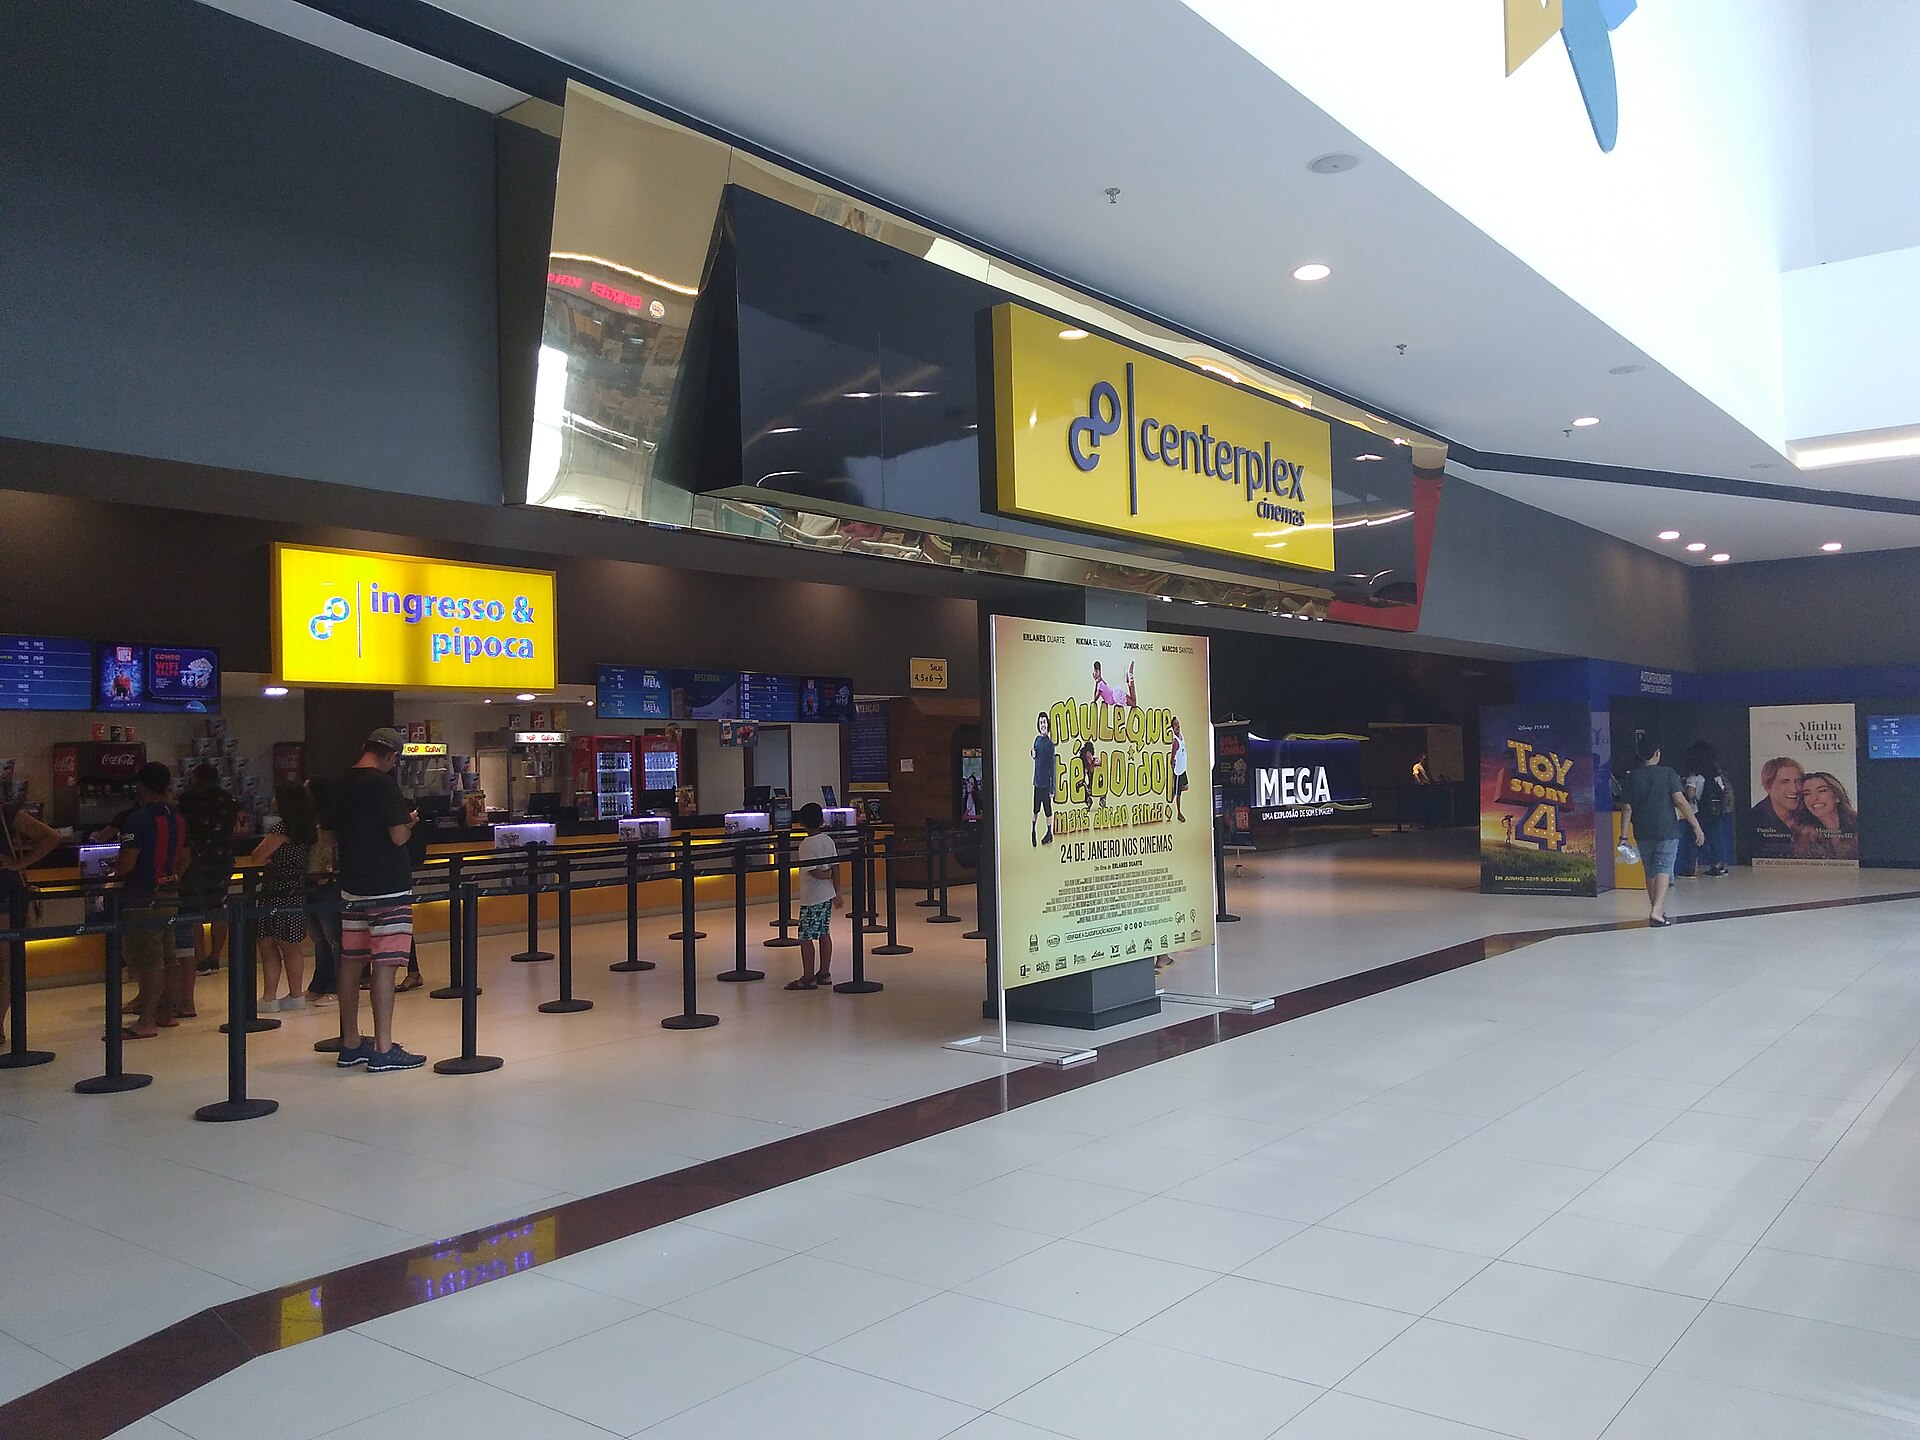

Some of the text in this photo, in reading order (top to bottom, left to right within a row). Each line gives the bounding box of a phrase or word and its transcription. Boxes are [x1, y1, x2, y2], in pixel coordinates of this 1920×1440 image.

[1141, 417, 1305, 502] centerplex
[1256, 497, 1305, 527] cinemas
[370, 582, 534, 624] ingresso &
[432, 626, 534, 663] pipoca
[1023, 633, 1066, 645] ERLANES DUARTE
[1123, 641, 1139, 651] JUNIOR
[1161, 645, 1178, 654] MARCOS
[930, 674, 935, 682] 6
[1786, 731, 1837, 742] vida em
[1799, 720, 1842, 731] Minha
[1804, 741, 1845, 751] Marte
[1507, 739, 1574, 786] TOY
[1256, 766, 1331, 807] MEGA
[1511, 779, 1568, 803] STORY
[1262, 812, 1273, 821] UMA
[1273, 809, 1299, 820] EXPLOSÃO
[1299, 810, 1306, 818] DE
[1319, 807, 1334, 816] IMAGEM
[1524, 803, 1562, 850] 4
[1060, 833, 1174, 864] 24 DE JANEIRO NOS CINEMAS
